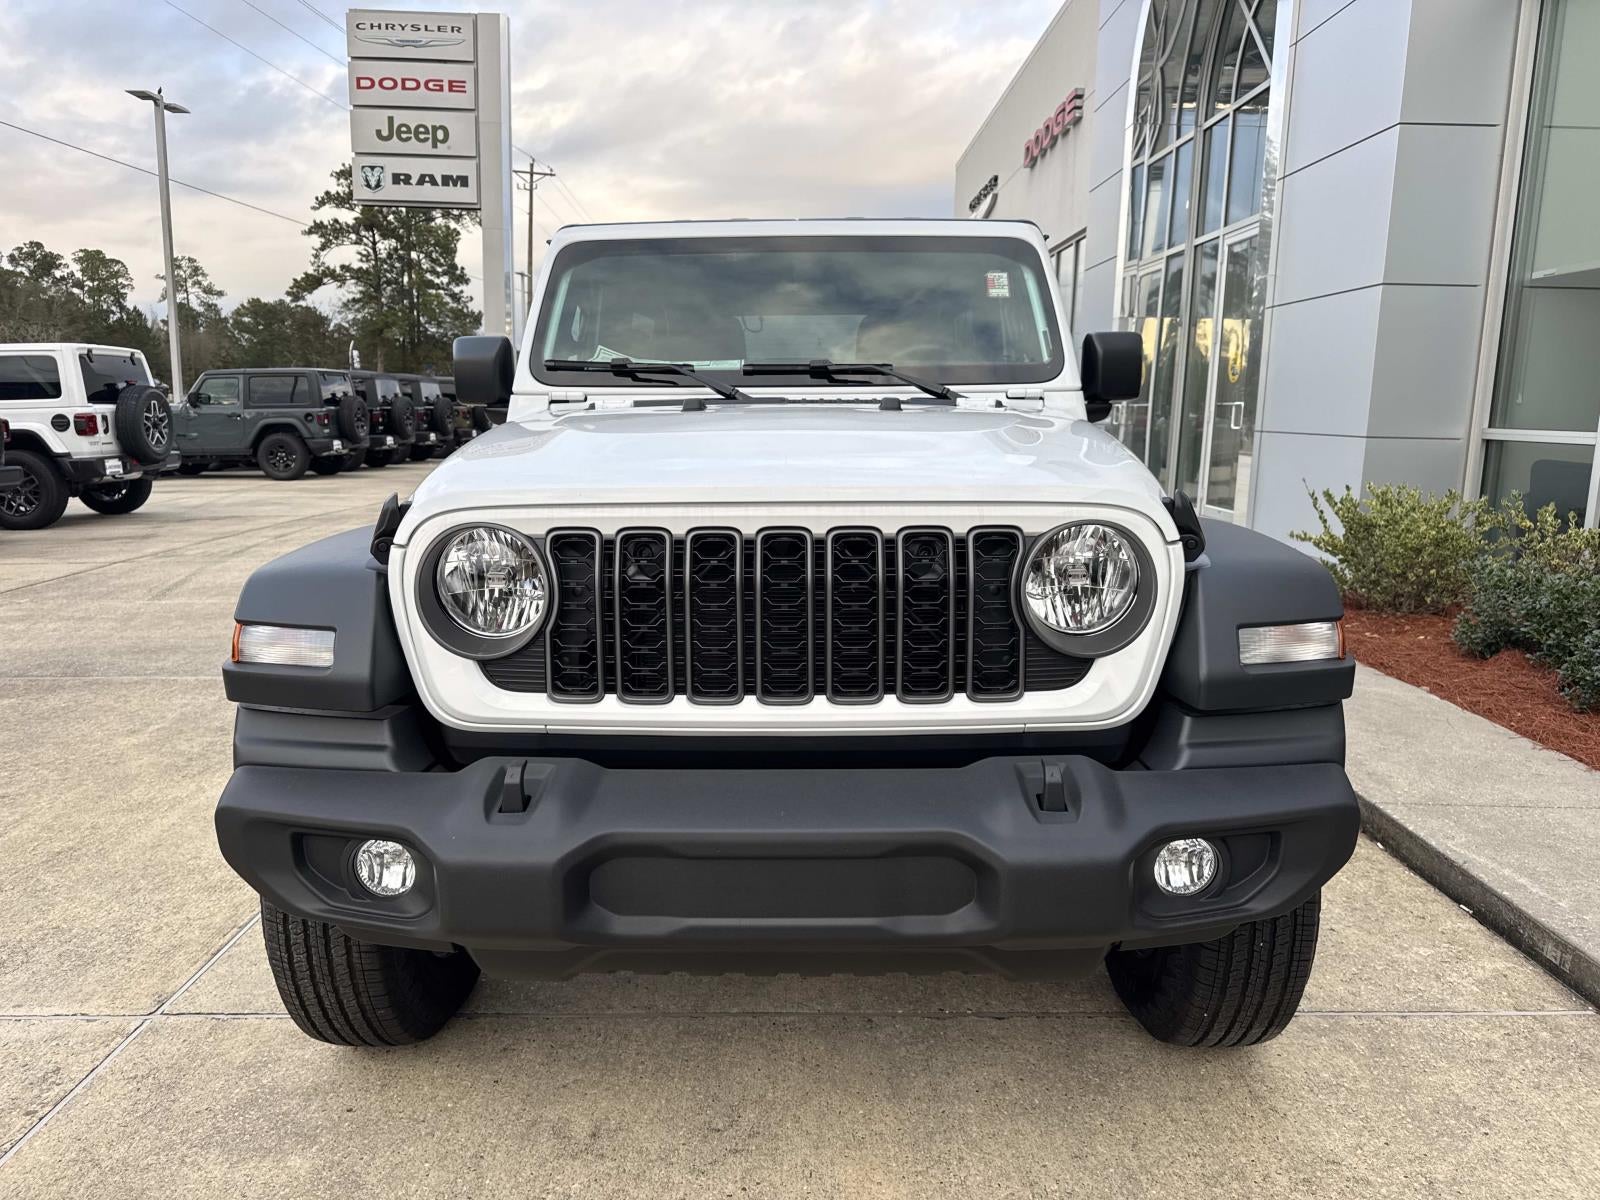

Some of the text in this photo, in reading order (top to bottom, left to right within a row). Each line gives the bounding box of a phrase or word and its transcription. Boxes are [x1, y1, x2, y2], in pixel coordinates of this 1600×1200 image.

[355, 22, 463, 33] CHRYSLER
[355, 76, 467, 94] DODGE
[375, 116, 450, 149] Jeep
[1023, 88, 1085, 168] DODGE
[391, 172, 469, 188] RAM
